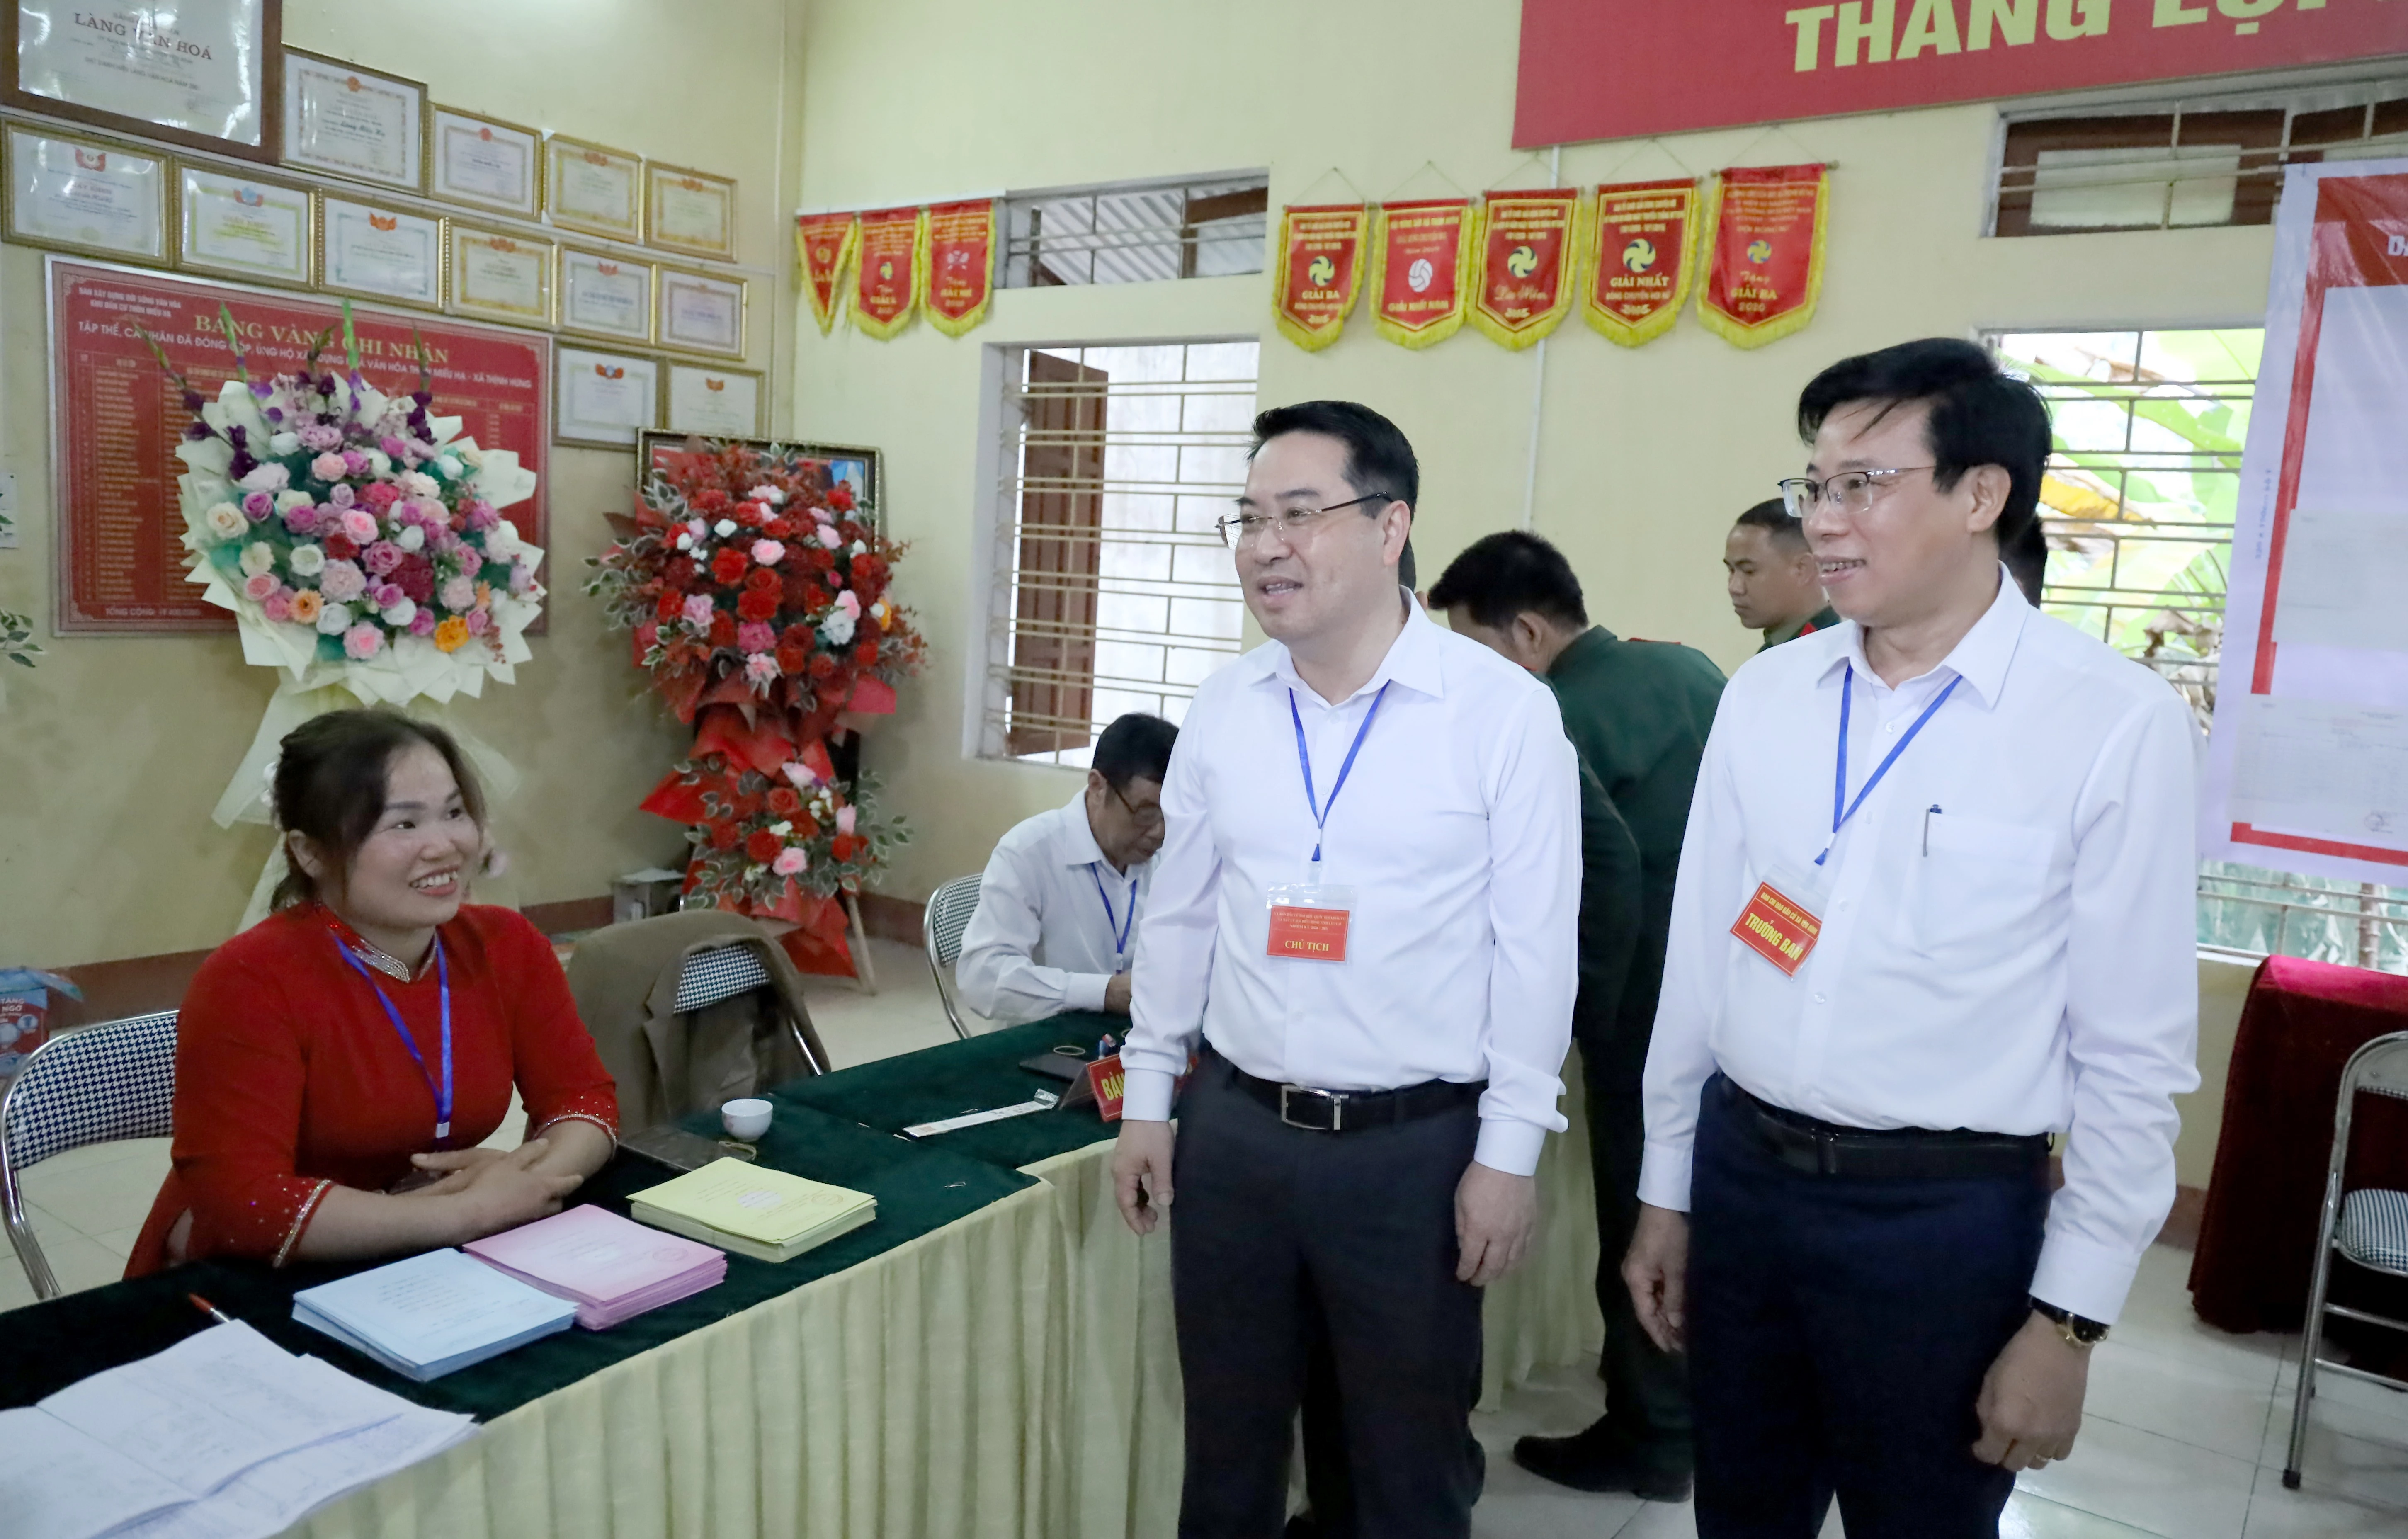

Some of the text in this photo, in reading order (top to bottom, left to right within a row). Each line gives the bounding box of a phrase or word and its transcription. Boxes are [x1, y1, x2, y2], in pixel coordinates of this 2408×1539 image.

[74, 12, 126, 36] LÀNG
[1610, 272, 1670, 287] GIẢI NHẤT
[1731, 284, 1757, 299] GIẢI
[78, 320, 99, 334] TẬP
[176, 334, 192, 345] ĐÃ
[1285, 939, 1329, 953] CHỦ TỊCH
[1745, 912, 1804, 961] TRƯỞNG BAN
